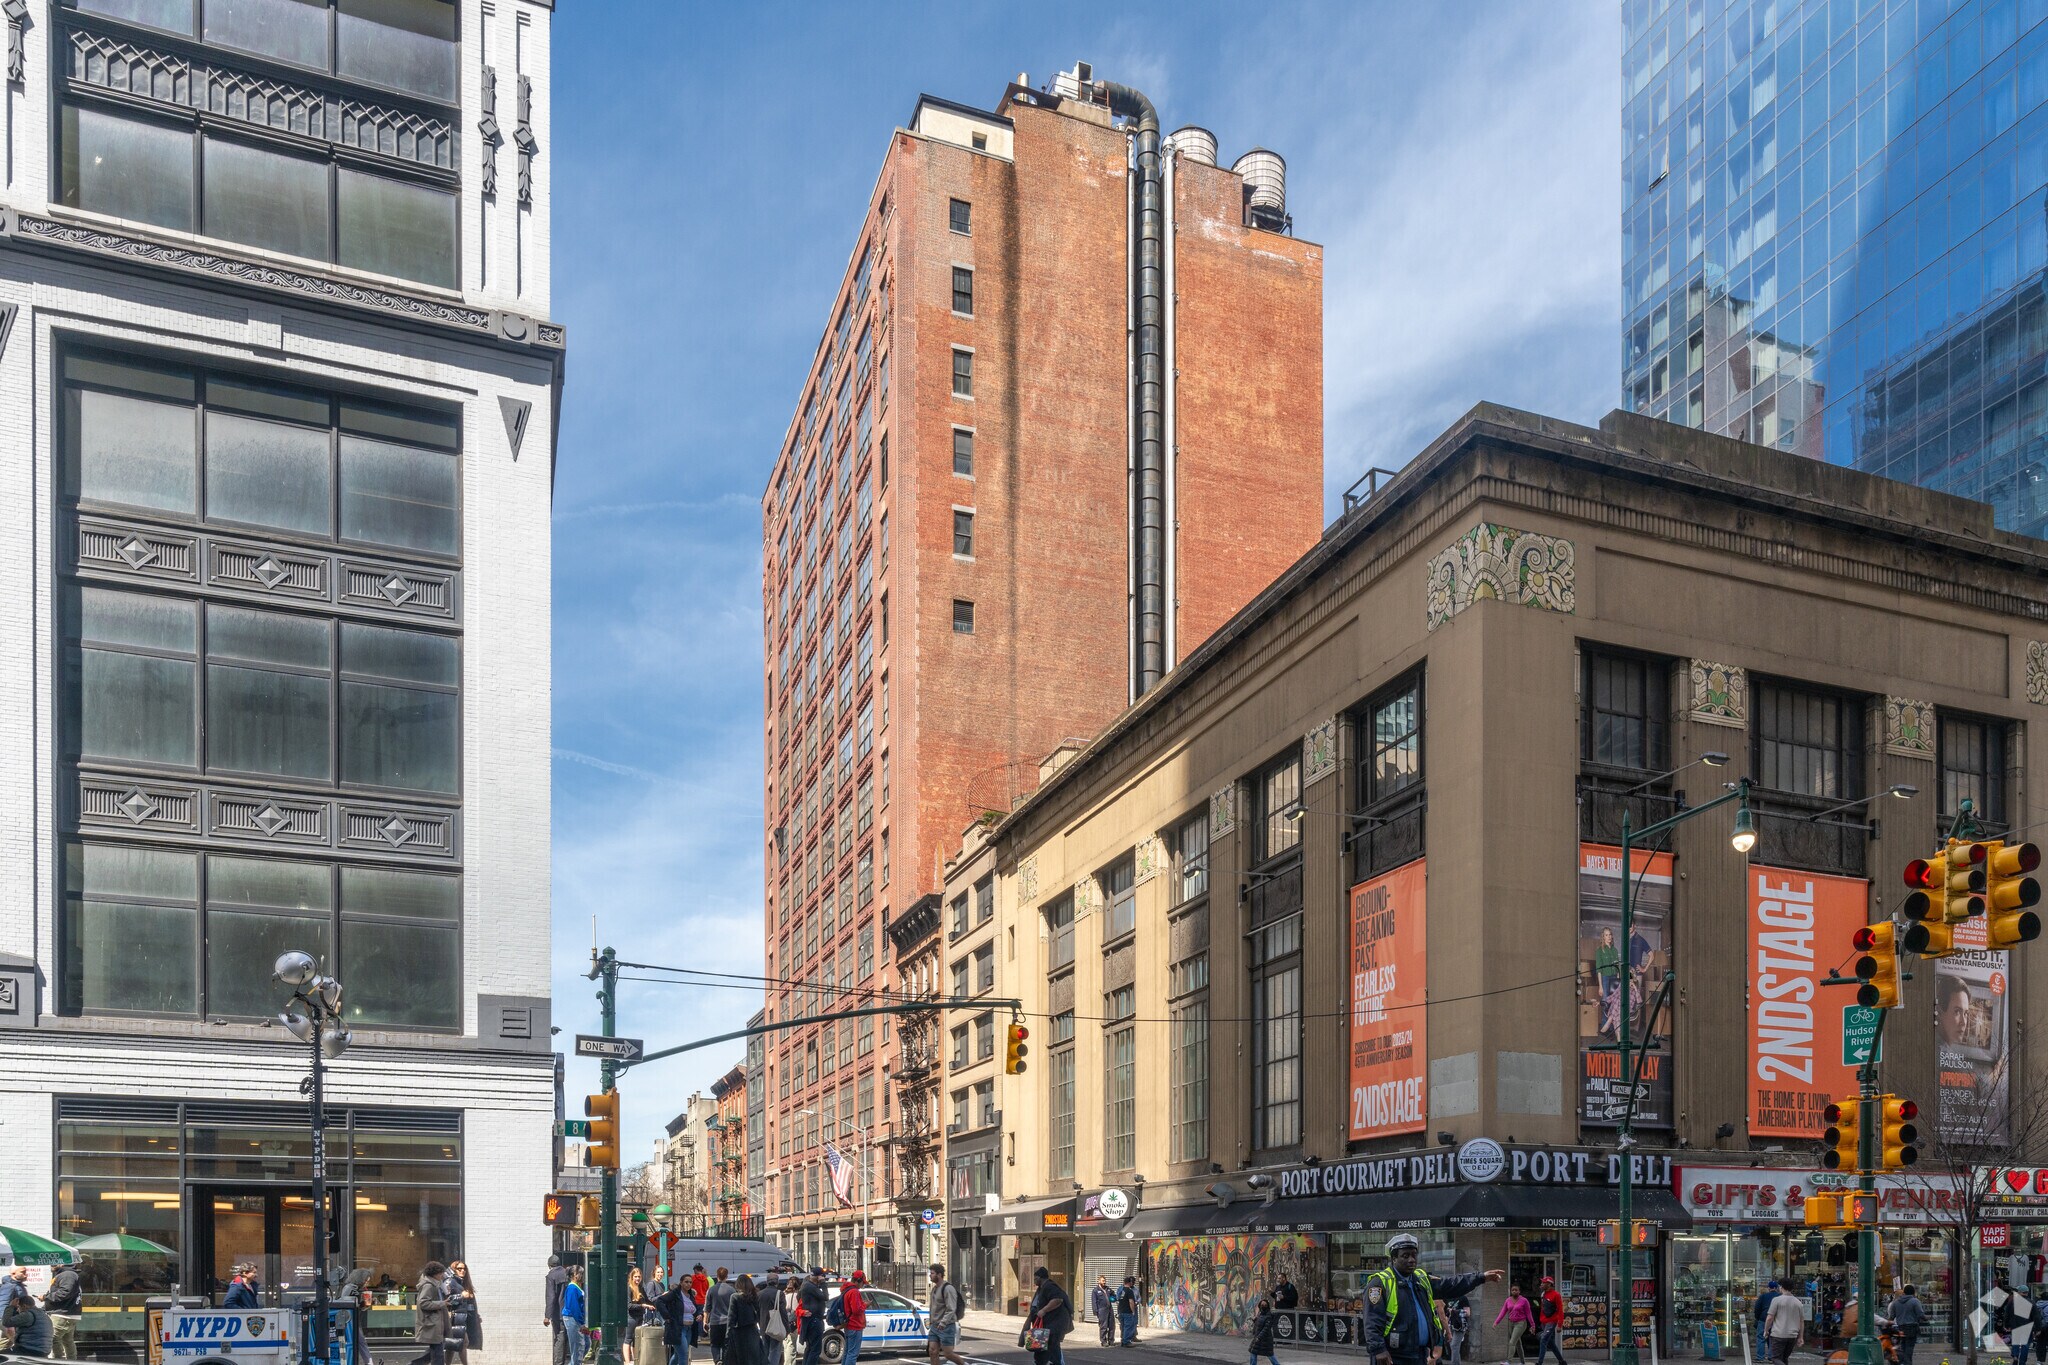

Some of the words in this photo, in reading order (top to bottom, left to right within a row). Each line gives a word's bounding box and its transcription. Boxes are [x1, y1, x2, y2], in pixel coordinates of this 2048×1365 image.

[1586, 855, 1604, 870] HAYES
[1607, 858, 1622, 871] THEAT
[1356, 885, 1391, 920] GROUND-
[1356, 909, 1394, 946] BREAKING
[1962, 928, 1986, 936] BROADWA
[1355, 943, 1377, 974] PAST.
[1354, 964, 1396, 1000] FEARLESS
[1757, 875, 1814, 1084] 2NDSTAGE
[1354, 994, 1387, 1027] FUTURE.
[585, 1042, 604, 1051] ONE
[613, 1045, 632, 1053] WAY
[1354, 1038, 1376, 1055] SUBSCRIBE
[1377, 1037, 1382, 1049] TO
[1852, 1037, 1873, 1046] River
[1354, 1055, 1365, 1068] 45TH
[1366, 1050, 1394, 1066] ANNIVERSARY
[1395, 1045, 1412, 1060] SEASON
[1940, 1052, 1964, 1060] SARAH
[1586, 1053, 1620, 1078] MOTH
[1940, 1060, 1973, 1069] PAULSON
[1591, 1078, 1609, 1091] PAULA
[1354, 1076, 1422, 1130] 2NDSTAGE
[1758, 1090, 1771, 1108] THE
[1774, 1091, 1794, 1109] HOME
[1797, 1092, 1806, 1110] OF
[1808, 1093, 1831, 1110] LIVING
[1758, 1110, 1796, 1128] AMERICAN
[573, 1122, 578, 1134] 8
[1282, 1168, 1320, 1196] PORT
[1324, 1158, 1406, 1193] GOURMET
[1411, 1153, 1455, 1186] DELI
[1512, 1150, 1589, 1182] PORT
[1608, 1154, 1672, 1185] DELI
[1812, 1174, 1849, 1184] CITY
[1693, 1183, 1776, 1206] GIFTS
[1786, 1185, 1805, 1206] &
[2017, 1208, 2032, 1216] MONEY
[1349, 1222, 1362, 1230] SODA
[1371, 1221, 1388, 1229] CANDY
[1398, 1220, 1430, 1228] CIGARETTES
[1542, 1219, 1568, 1227] HOUSE
[1570, 1219, 1580, 1227] OF
[1983, 1227, 2005, 1235] VAPE
[1983, 1236, 2005, 1244] SHOP
[1632, 1280, 1655, 1296] ATM
[175, 1317, 242, 1338] NYPD
[887, 1318, 920, 1332] NYPD
[174, 1348, 188, 1356] 9671
